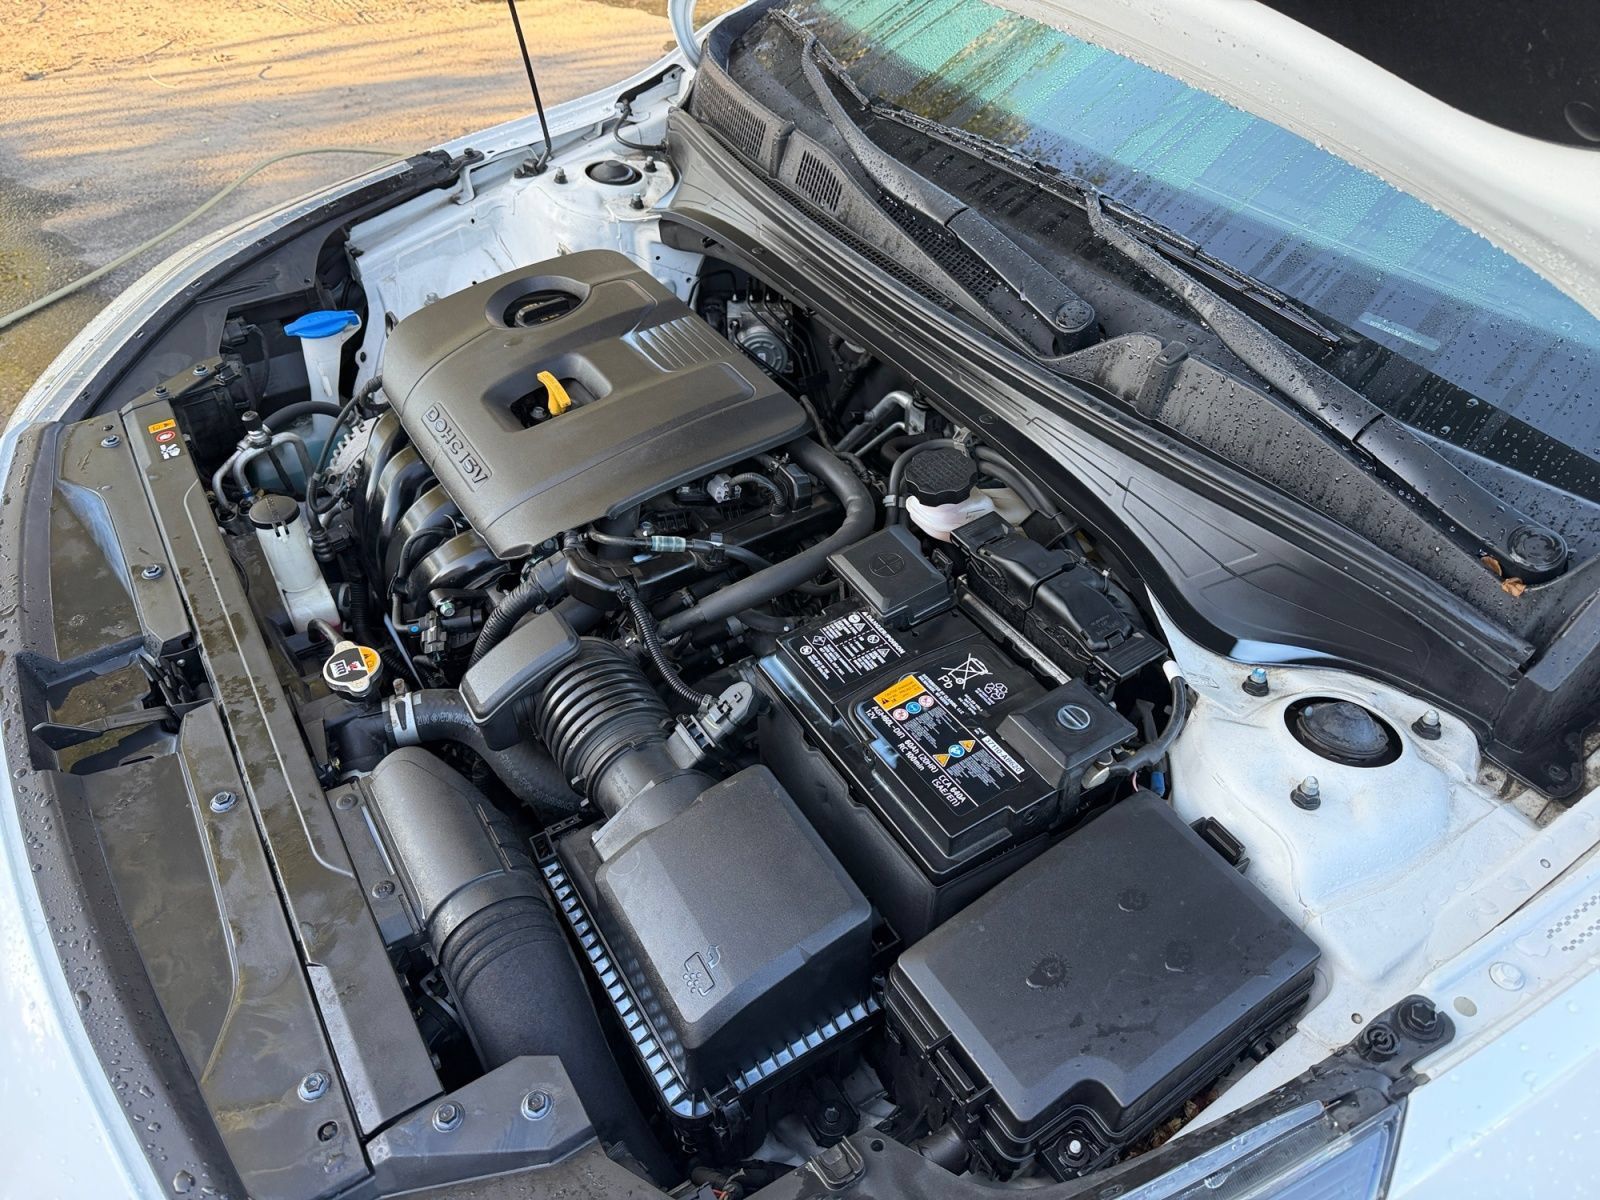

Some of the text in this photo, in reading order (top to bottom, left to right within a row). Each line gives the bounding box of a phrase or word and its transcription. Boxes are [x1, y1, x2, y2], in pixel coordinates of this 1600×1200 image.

[425, 405, 464, 455] DOHC
[938, 674, 953, 688] Pb
[866, 708, 878, 720] 12V
[898, 743, 925, 771] RC 100min
[904, 738, 919, 755] 60Ah
[918, 752, 938, 774] (20HR)
[938, 774, 966, 803] CCA 640A
